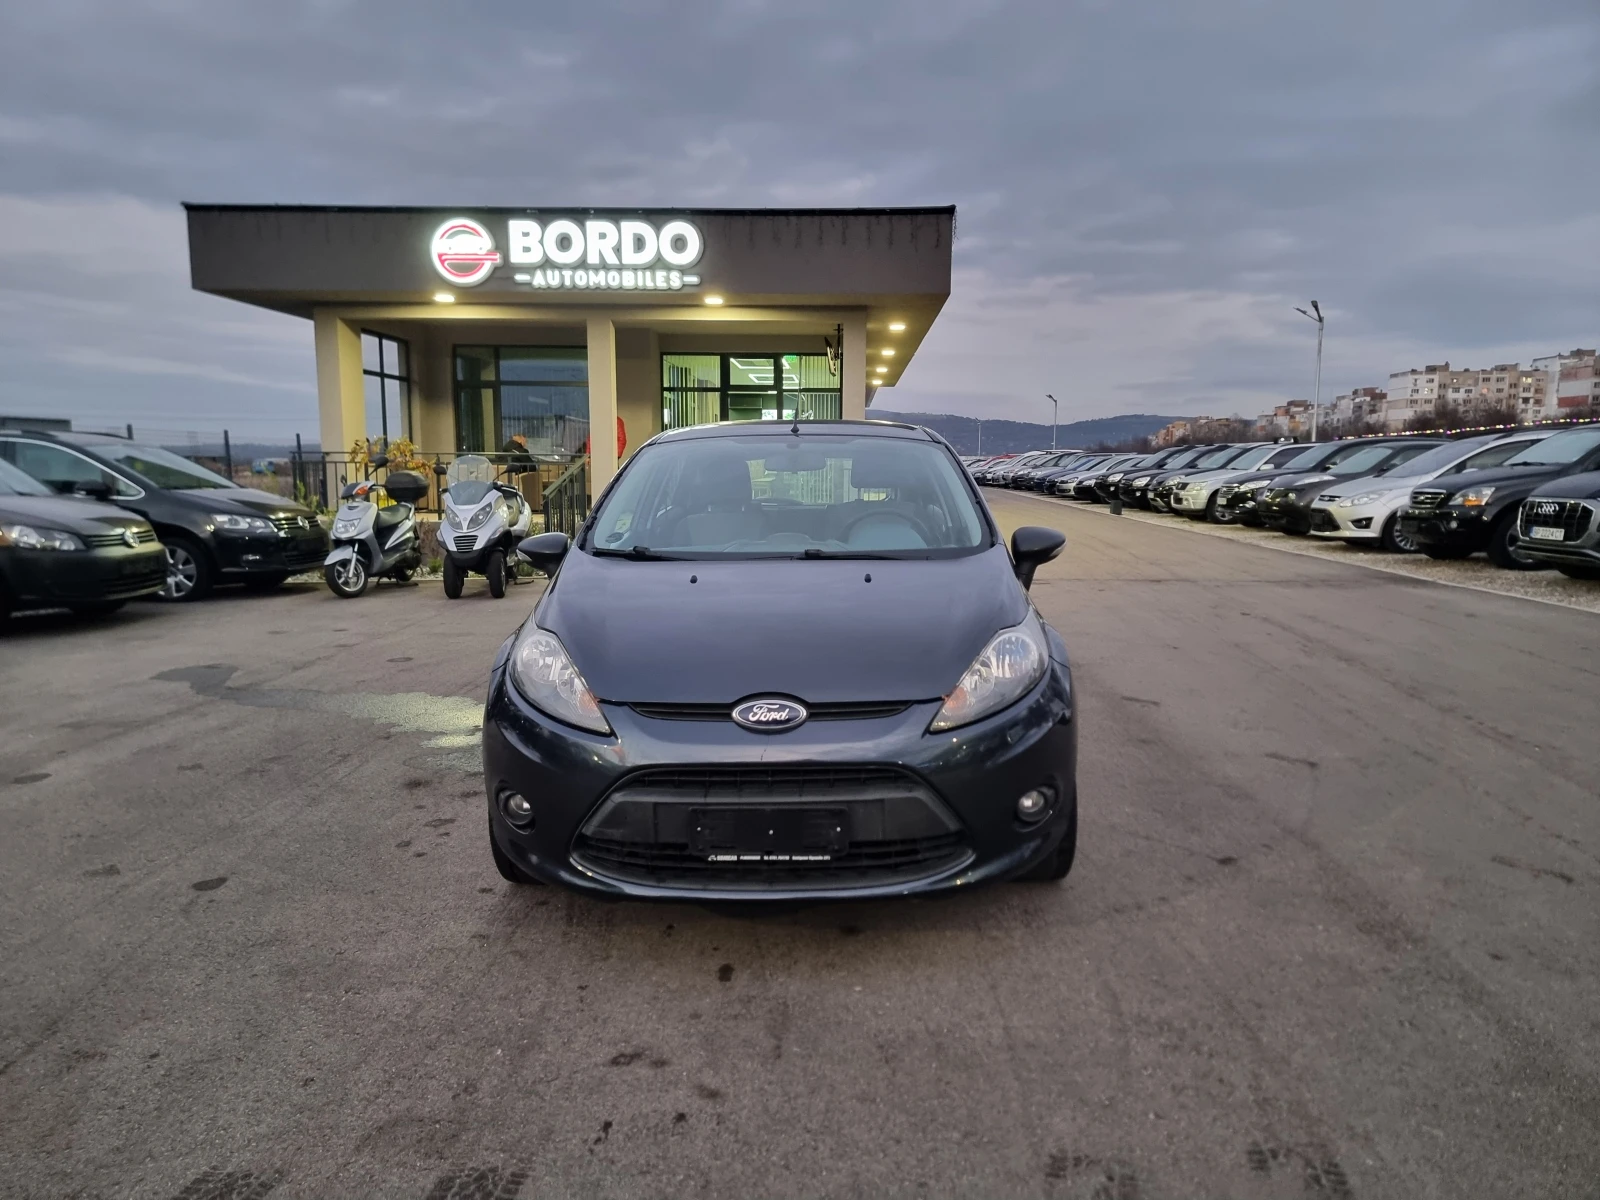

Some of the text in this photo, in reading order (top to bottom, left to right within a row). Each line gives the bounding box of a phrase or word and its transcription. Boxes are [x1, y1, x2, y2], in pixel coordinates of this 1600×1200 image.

[507, 219, 701, 266] BORDO
[532, 269, 682, 289] AUTOMOBILES
[748, 703, 790, 722] Ford
